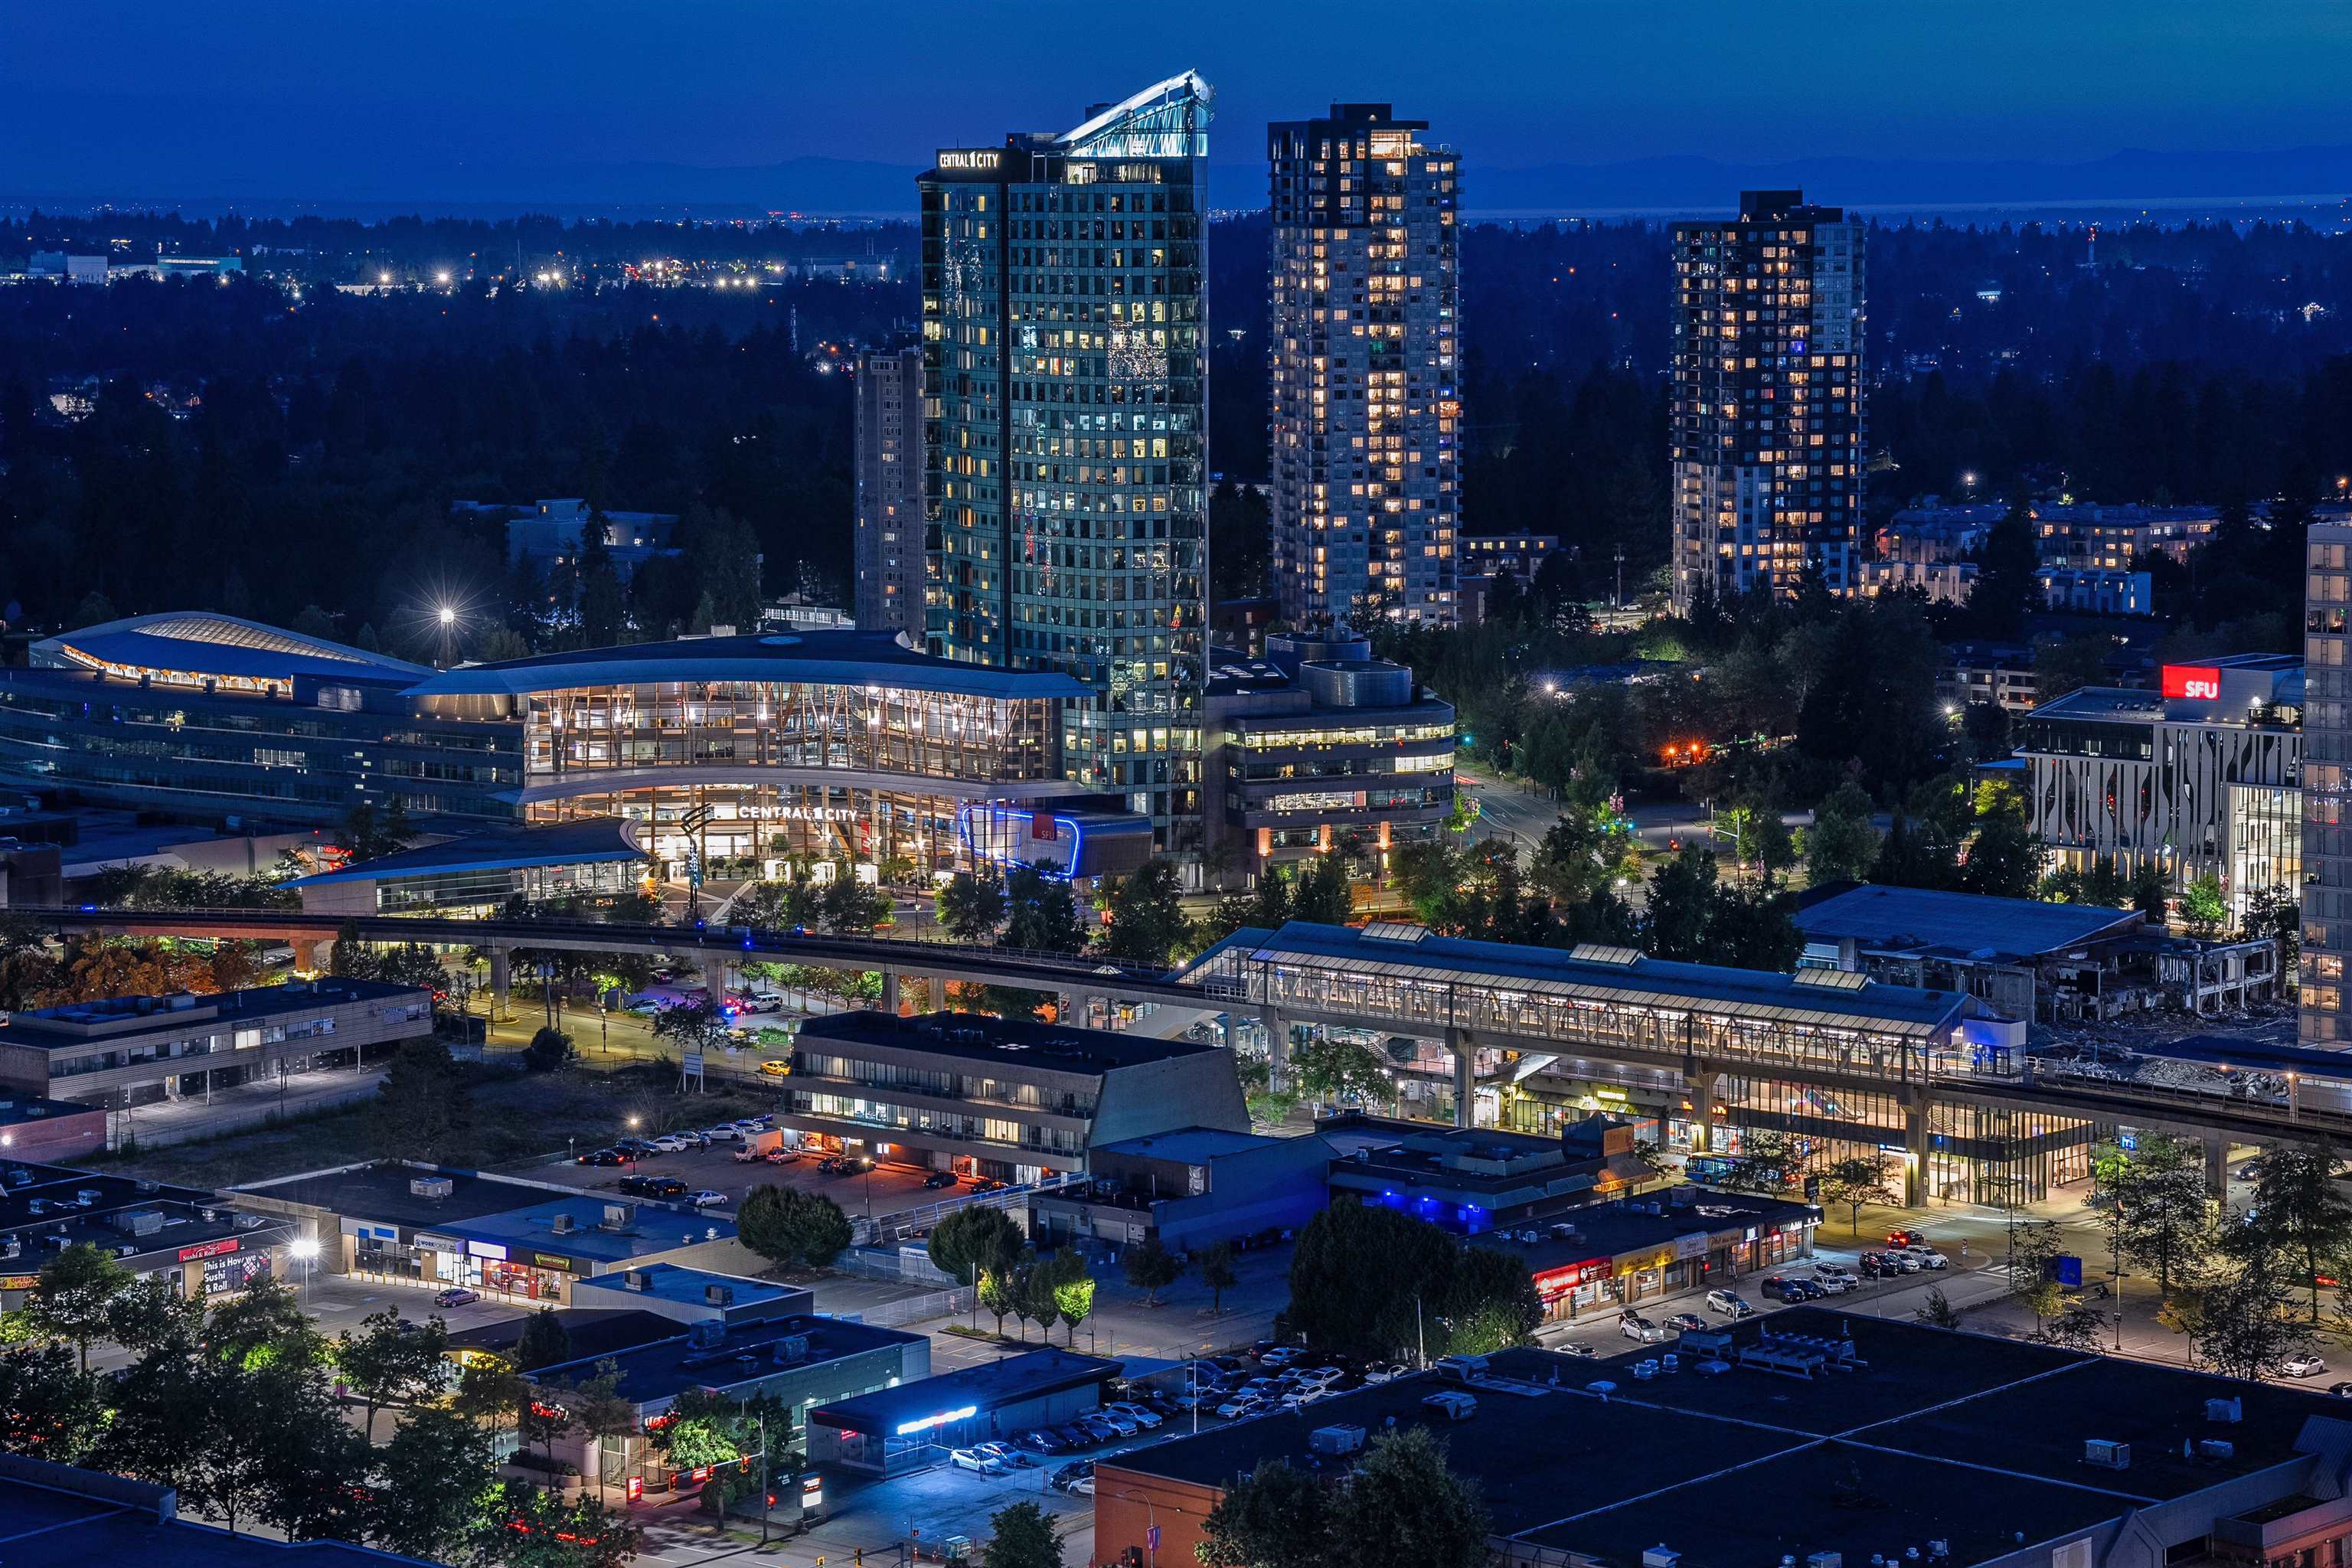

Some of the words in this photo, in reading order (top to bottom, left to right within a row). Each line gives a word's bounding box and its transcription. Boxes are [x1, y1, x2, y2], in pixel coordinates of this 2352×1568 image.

[940, 154, 969, 168] CENTRAL
[976, 154, 998, 168] CITY
[2185, 680, 2218, 699] SFU
[739, 806, 811, 821] CENTRAL
[825, 808, 858, 822] CITY
[1041, 830, 1054, 840] SFU
[204, 1260, 218, 1271] This
[219, 1259, 225, 1268] is
[227, 1257, 244, 1267] How
[245, 1254, 256, 1263] we
[204, 1269, 226, 1282] Sushi
[205, 1284, 211, 1294] &
[213, 1281, 227, 1292] Roll
